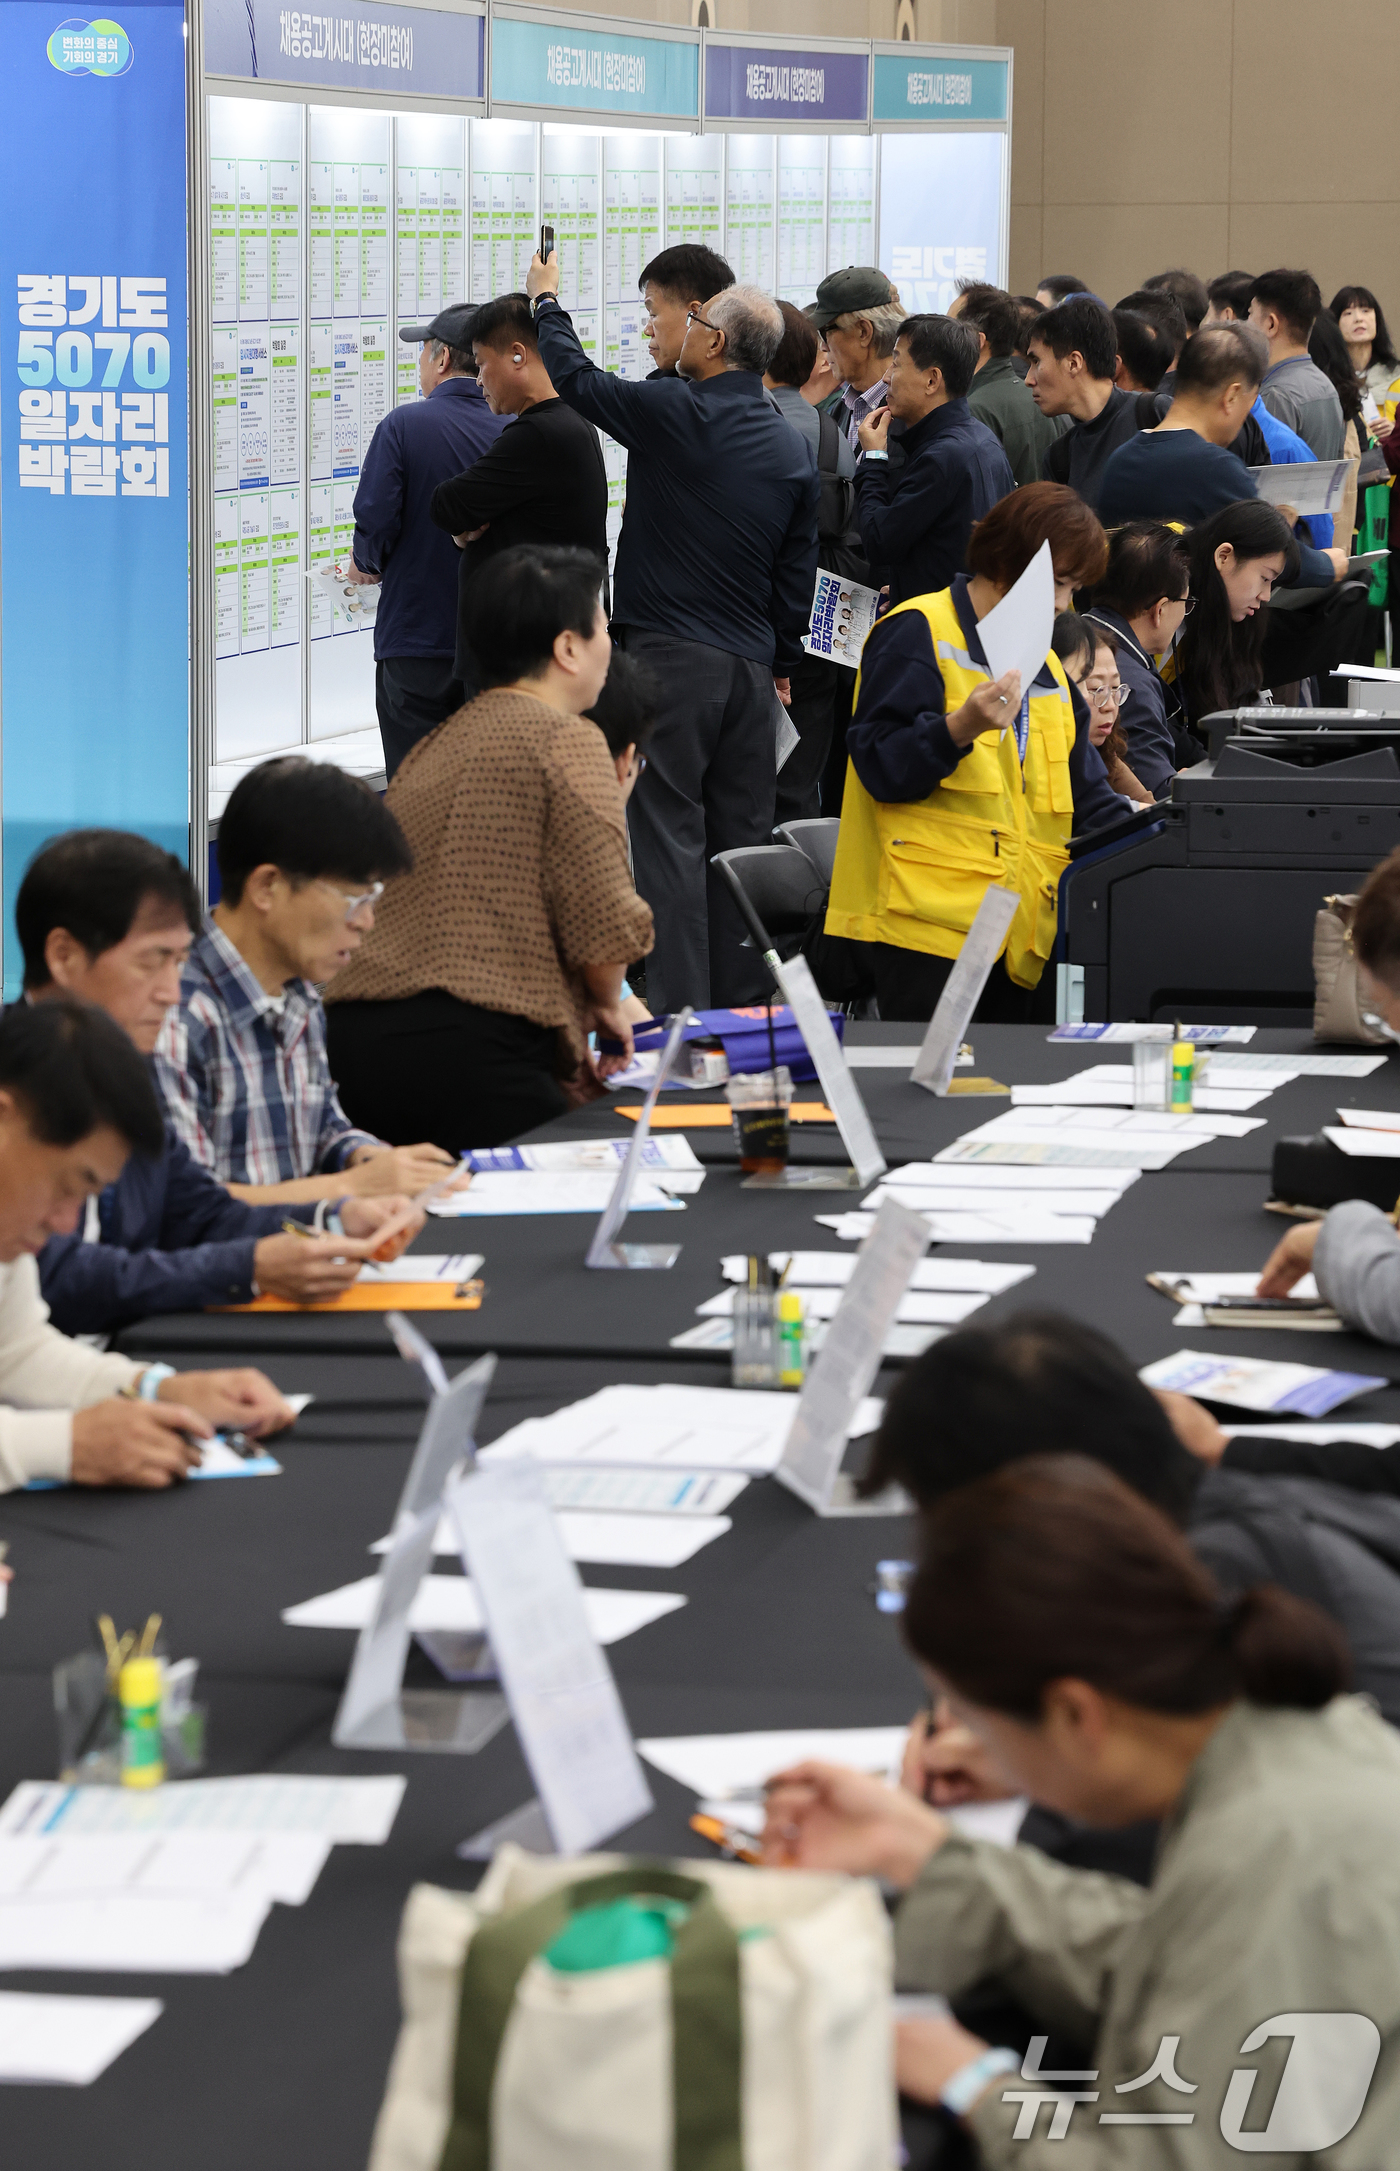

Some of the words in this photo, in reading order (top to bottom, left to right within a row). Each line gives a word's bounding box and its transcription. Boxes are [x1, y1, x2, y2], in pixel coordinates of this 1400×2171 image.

[62, 36, 95, 50] 변화의
[96, 37, 118, 50] 중심
[62, 50, 95, 64] 기회의
[96, 51, 118, 64] 경기
[280, 10, 354, 64] 채용공고게시대
[357, 20, 413, 71] (현장미참여)
[547, 44, 602, 89] 채용공고게시대
[603, 51, 646, 95] (현장미참여)
[746, 63, 790, 102] 채용공고게시대
[790, 66, 825, 104] (현장미참여)
[17, 274, 169, 328] 경기도
[17, 330, 171, 390] 5070
[18, 389, 169, 443] 일자리
[18, 444, 170, 497] 박람회
[822, 580, 841, 654] 일자리박람회
